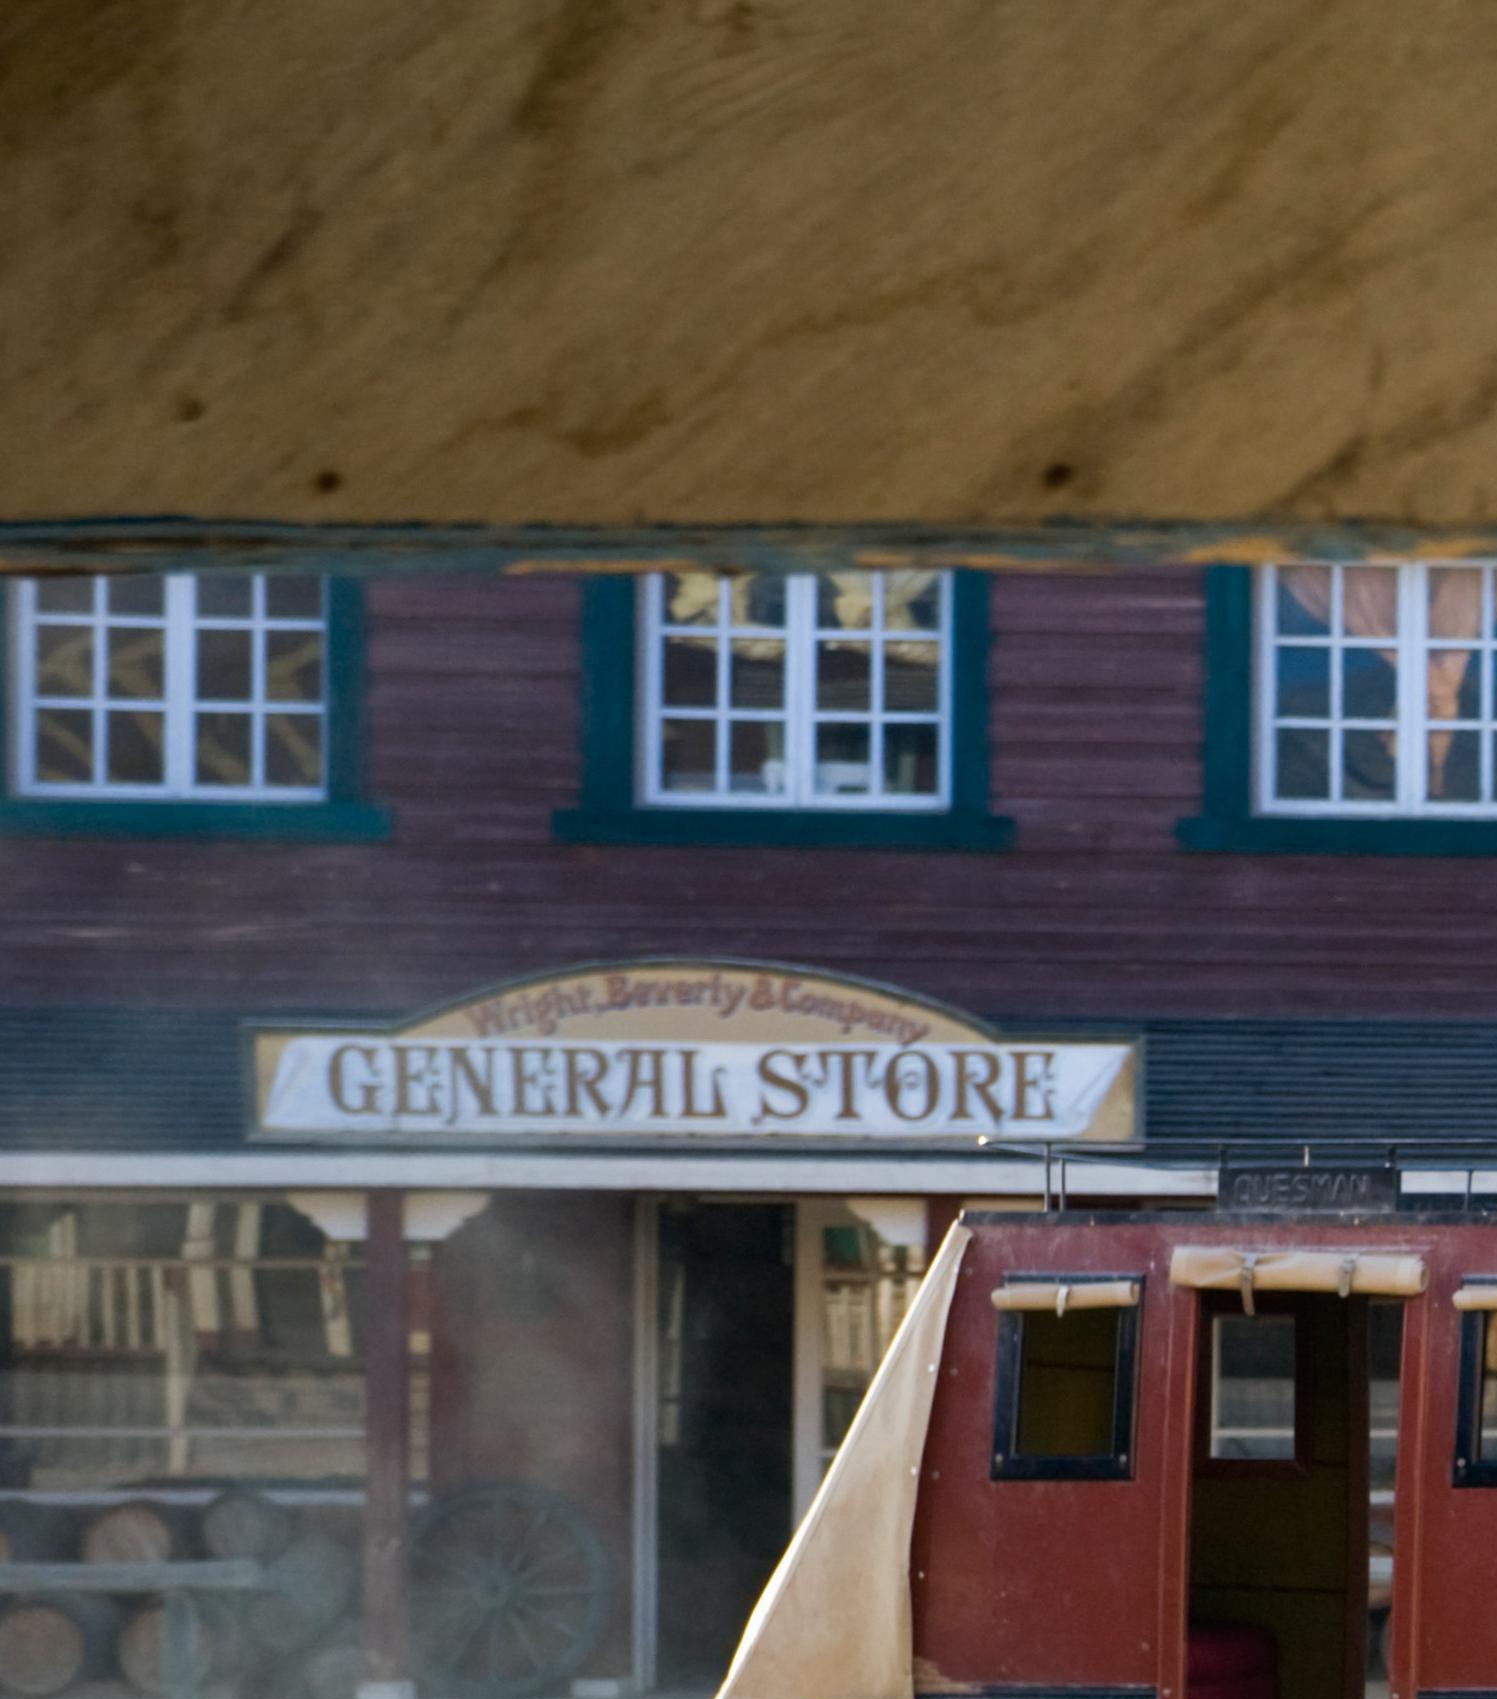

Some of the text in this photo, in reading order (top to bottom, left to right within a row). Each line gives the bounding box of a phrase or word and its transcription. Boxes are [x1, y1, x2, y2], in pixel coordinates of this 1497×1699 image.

[606, 973, 746, 1018] Beverly
[750, 973, 775, 1011] &
[781, 976, 931, 1045] Company
[328, 1044, 1058, 1125] GENERAL STORE
